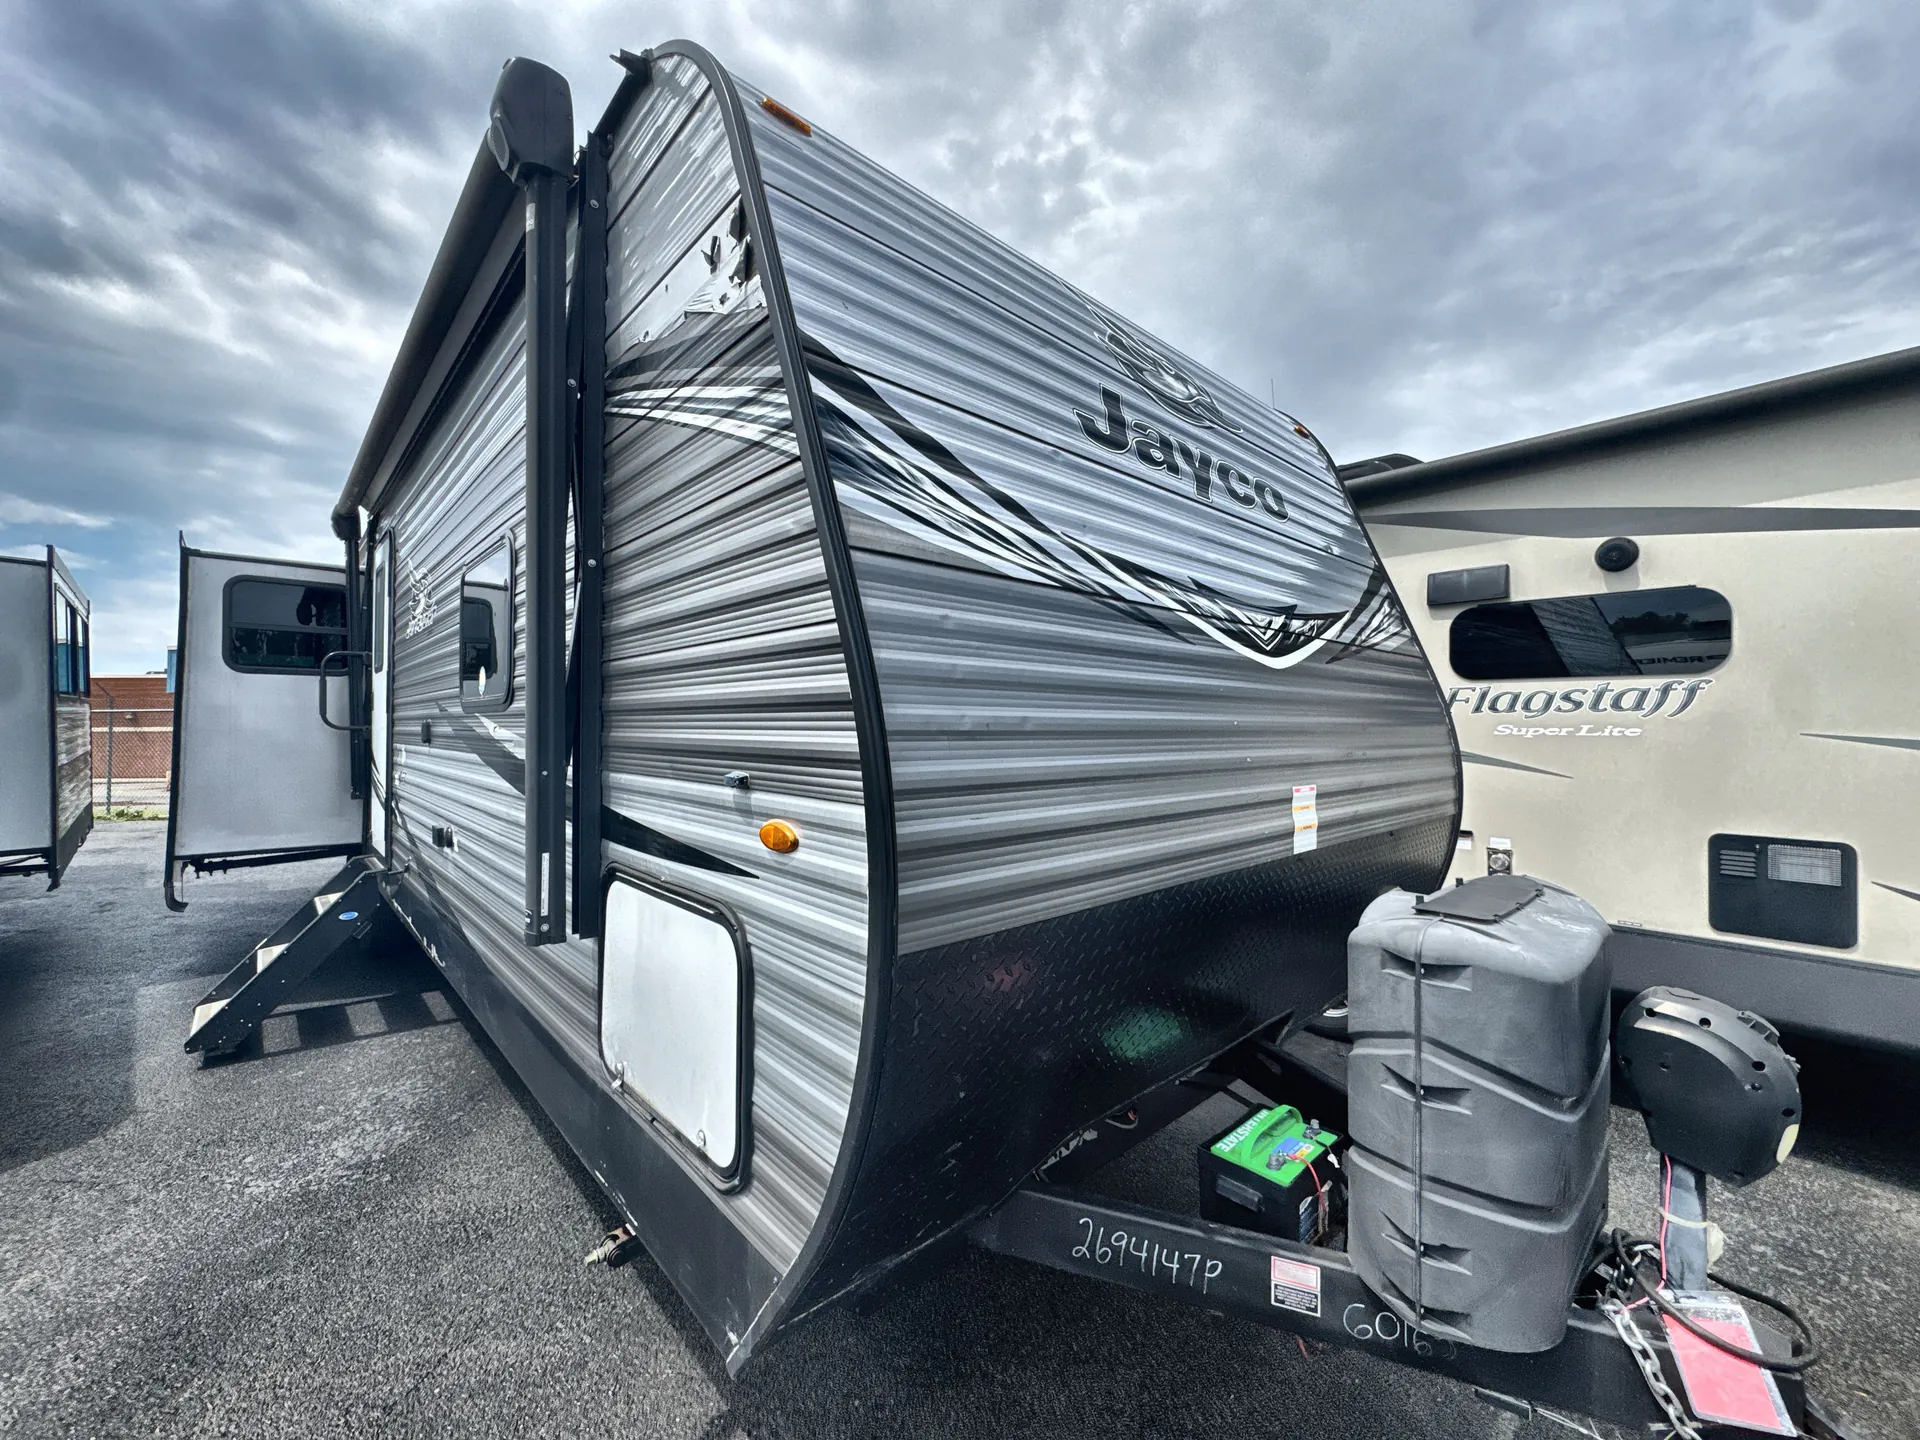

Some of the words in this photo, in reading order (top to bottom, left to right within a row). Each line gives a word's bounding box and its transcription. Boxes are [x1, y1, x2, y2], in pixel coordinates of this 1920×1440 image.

[1073, 383, 1290, 522] Jayco
[1447, 678, 1715, 719] Flagstaff
[1493, 724, 1574, 738] Super
[1576, 724, 1643, 737] Lite
